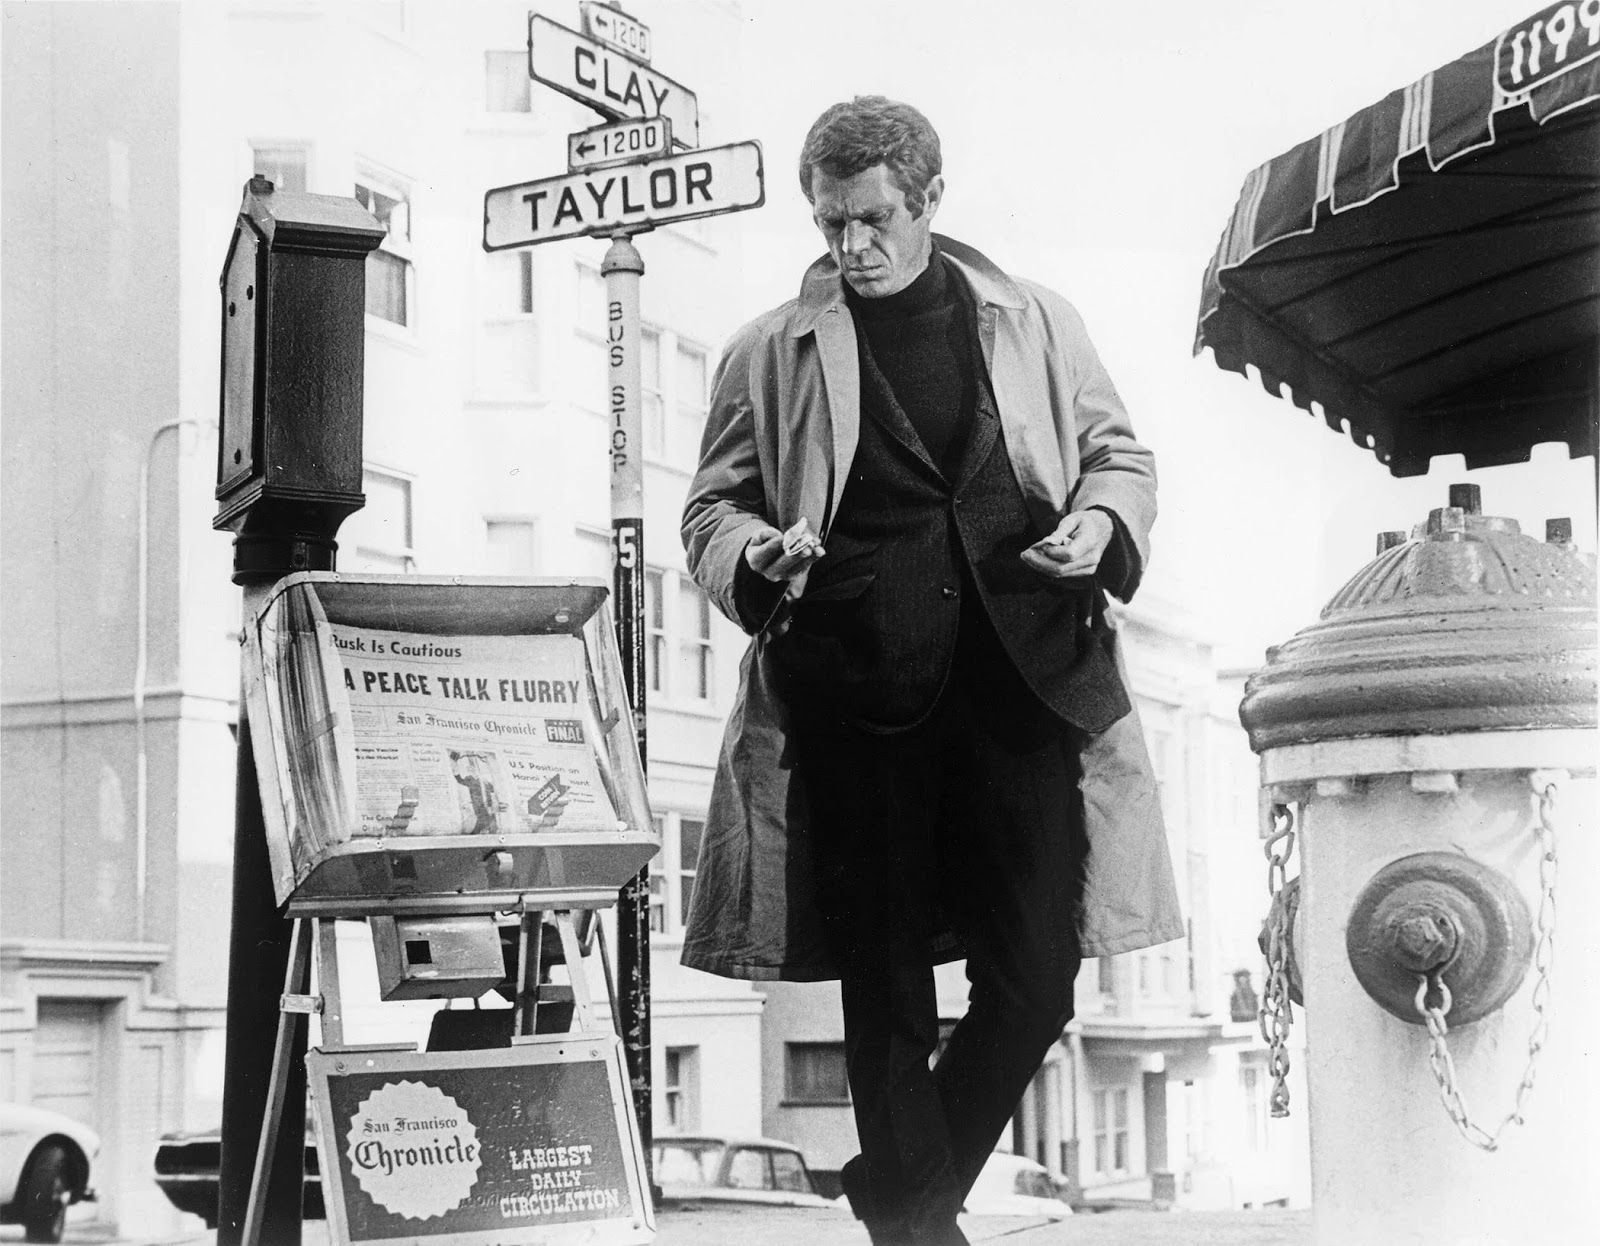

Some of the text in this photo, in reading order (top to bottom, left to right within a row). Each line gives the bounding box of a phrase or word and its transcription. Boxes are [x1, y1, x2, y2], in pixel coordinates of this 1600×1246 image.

[613, 19, 647, 54] 1200
[1510, 0, 1600, 84] 1199
[575, 46, 669, 117] CLAY
[603, 126, 656, 156] 1200
[522, 162, 713, 231] TAYLOR
[609, 301, 627, 473] BUS STOP
[619, 527, 637, 568] 5
[330, 634, 462, 657] Rusk Is Cautious
[344, 668, 580, 703] A PEACE TALK FLURRY
[397, 712, 421, 724] San
[425, 713, 480, 731] Francisco
[484, 720, 537, 736] Chronicle
[547, 726, 584, 742] FINAL
[529, 762, 566, 773] Position
[362, 1116, 458, 1136] San Francisco
[355, 1135, 476, 1176] Chronicle
[509, 1145, 593, 1170] LARGEST
[531, 1170, 582, 1190] DAILY
[500, 1188, 620, 1218] CIRCULATION
